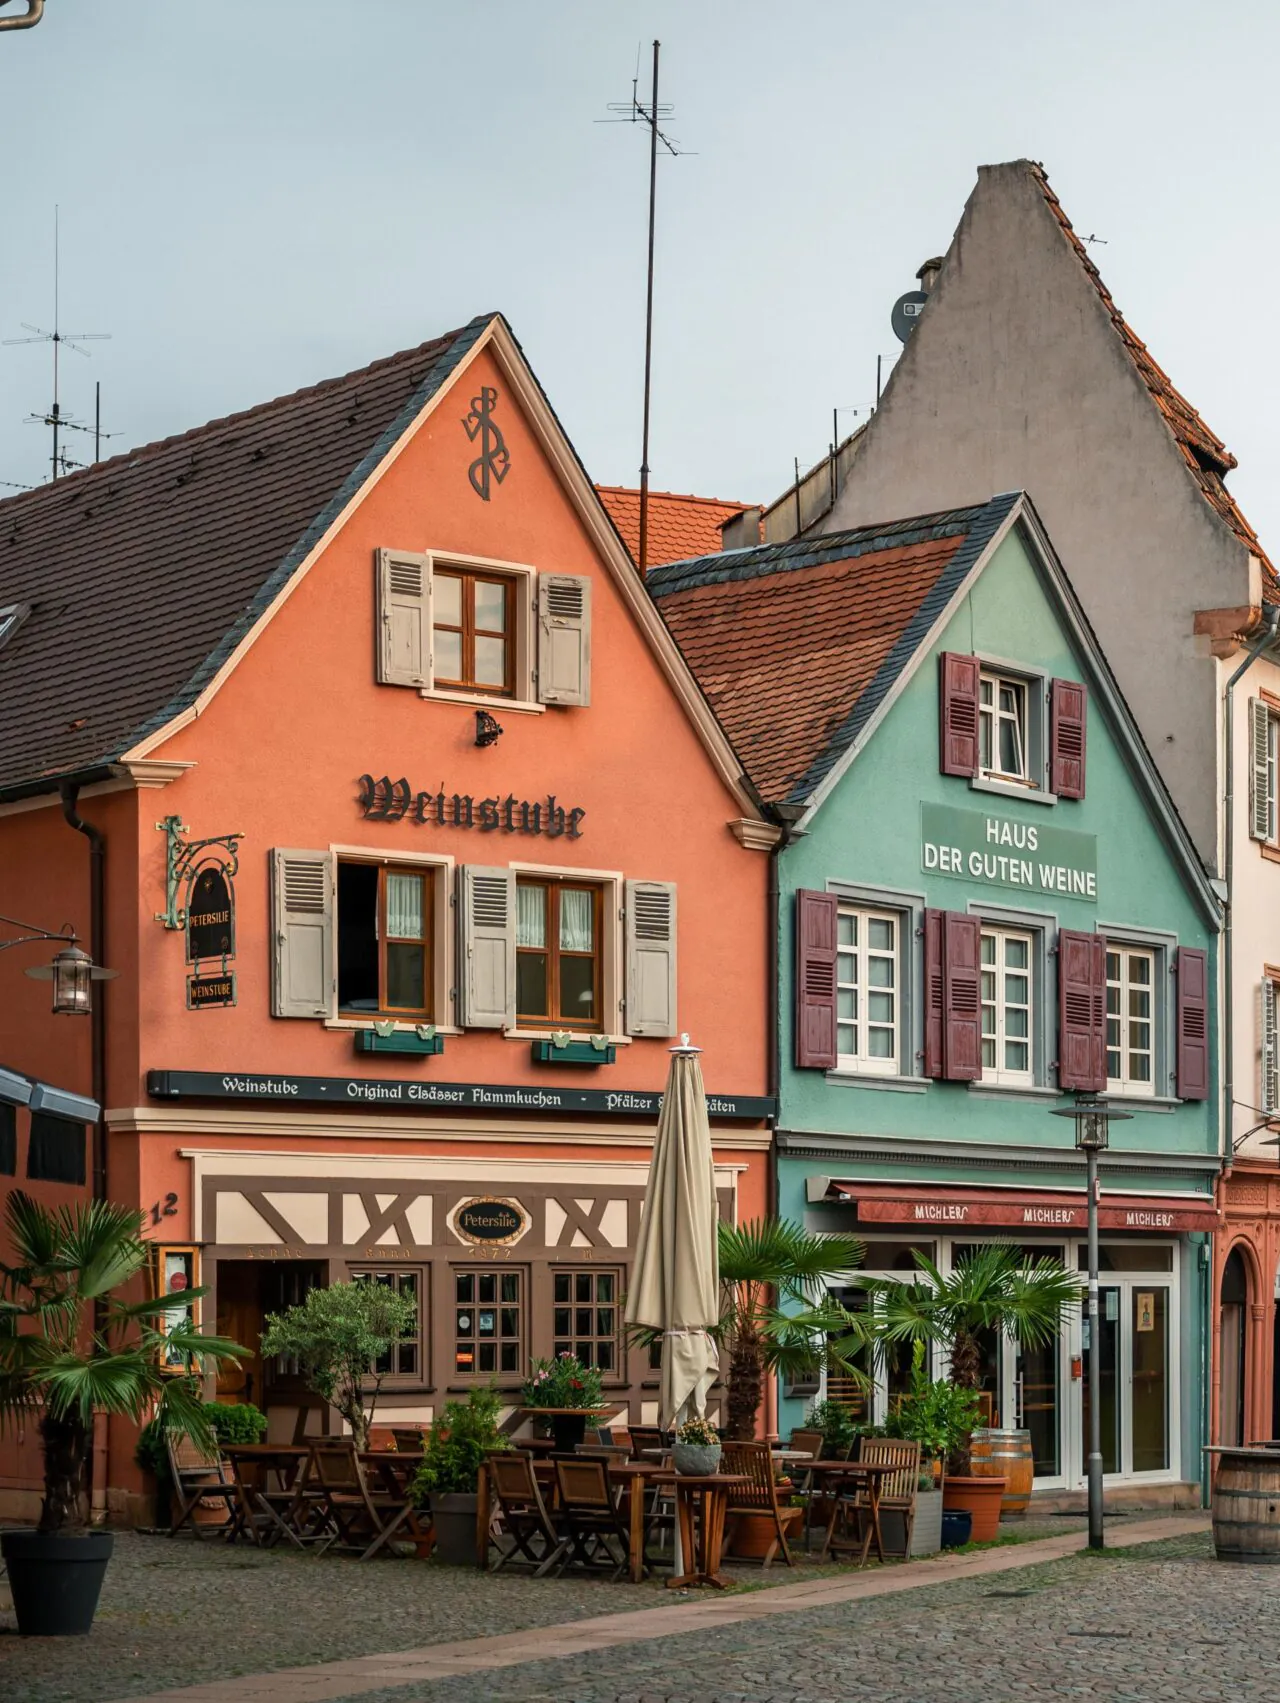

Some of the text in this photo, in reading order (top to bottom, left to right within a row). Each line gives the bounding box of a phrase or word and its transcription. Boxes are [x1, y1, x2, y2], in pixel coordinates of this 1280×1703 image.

[358, 773, 586, 840] Weinstube
[986, 818, 1038, 851] HAUS
[924, 843, 1096, 896] DER GUTEN WEINE
[189, 910, 229, 927] PETERSILIE
[190, 982, 231, 998] WEINSTUBE
[222, 1077, 299, 1095] Weinstube
[347, 1082, 402, 1100] Original
[408, 1084, 465, 1102] Elsässer
[471, 1087, 561, 1108] Flammkuchen
[604, 1093, 652, 1110] Pfälzer
[151, 1192, 178, 1226] 12
[464, 1212, 517, 1228] Petersilie
[914, 1204, 1174, 1227] MICHLERS MICHLERS MICHLERS
